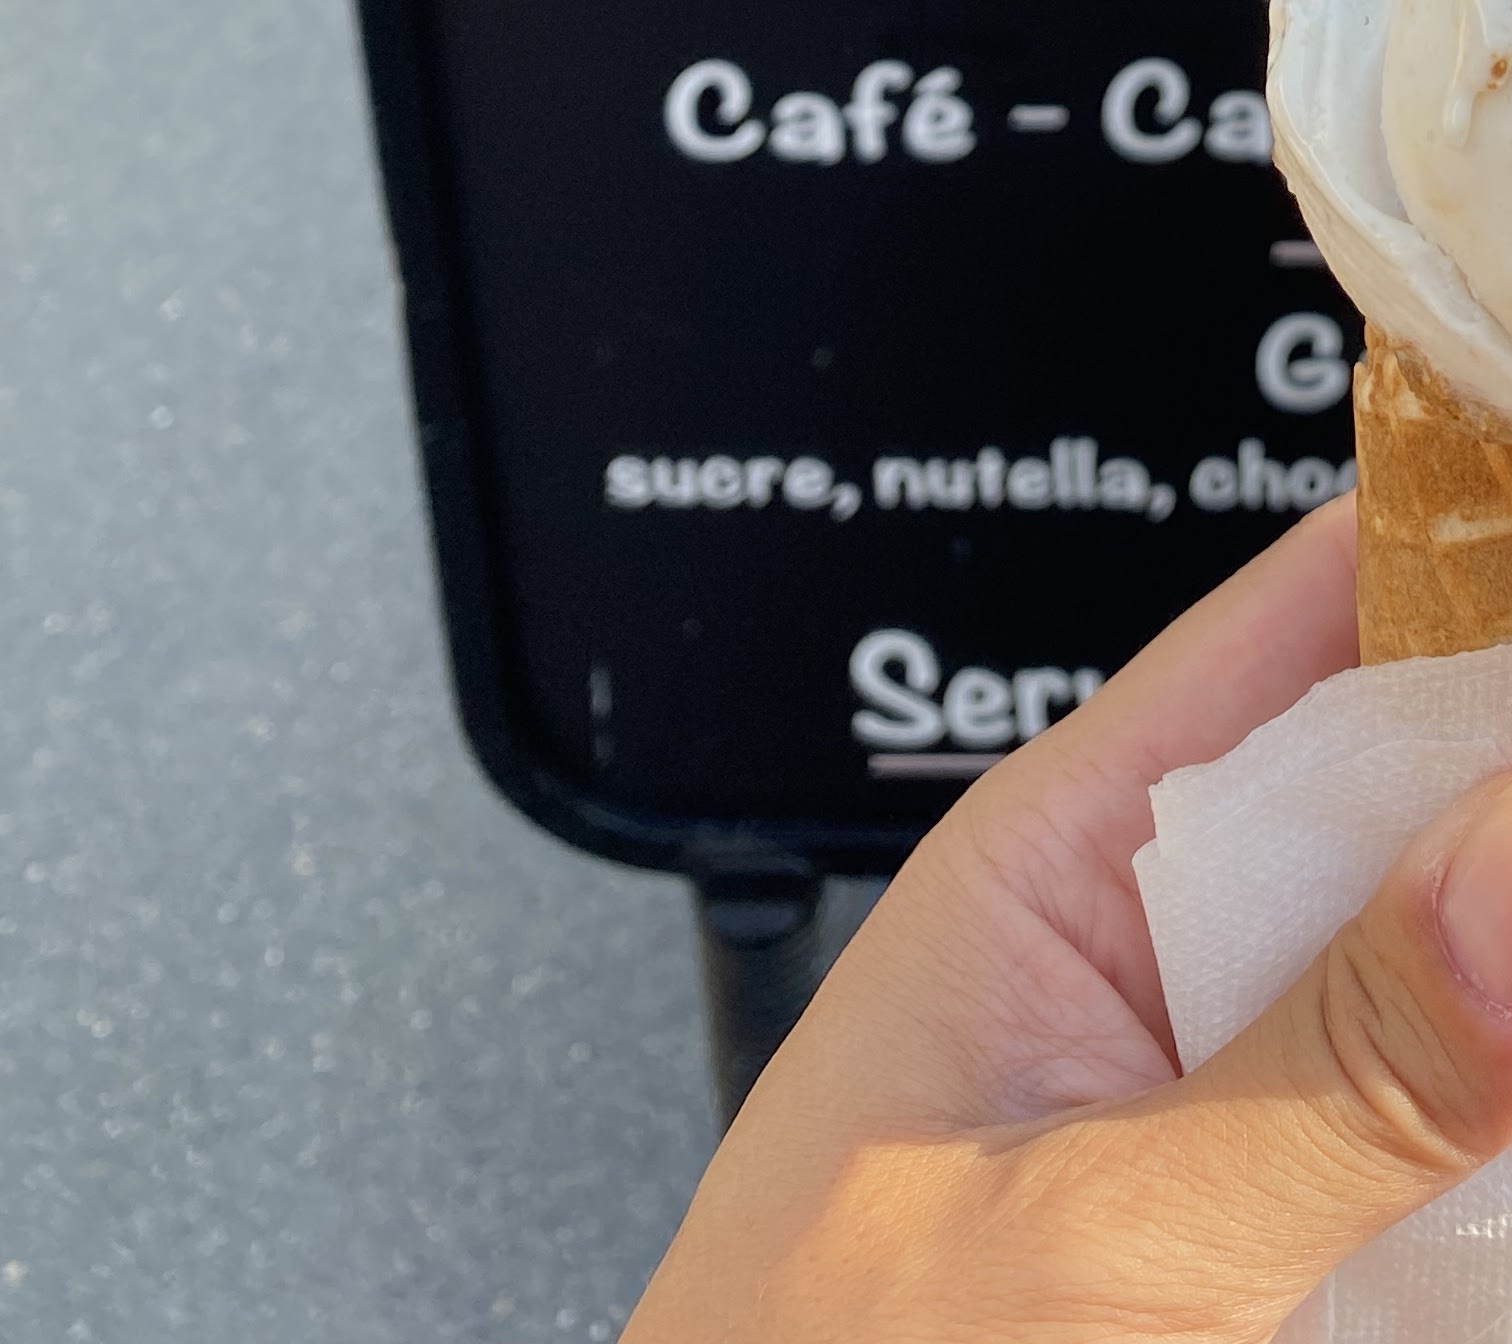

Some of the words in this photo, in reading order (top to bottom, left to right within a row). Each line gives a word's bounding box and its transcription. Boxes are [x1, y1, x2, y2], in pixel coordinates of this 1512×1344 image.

[664, 57, 977, 165] Café
[605, 452, 861, 521] sucre,
[872, 437, 1176, 521] nutella,
[848, 626, 1104, 750] Ser
